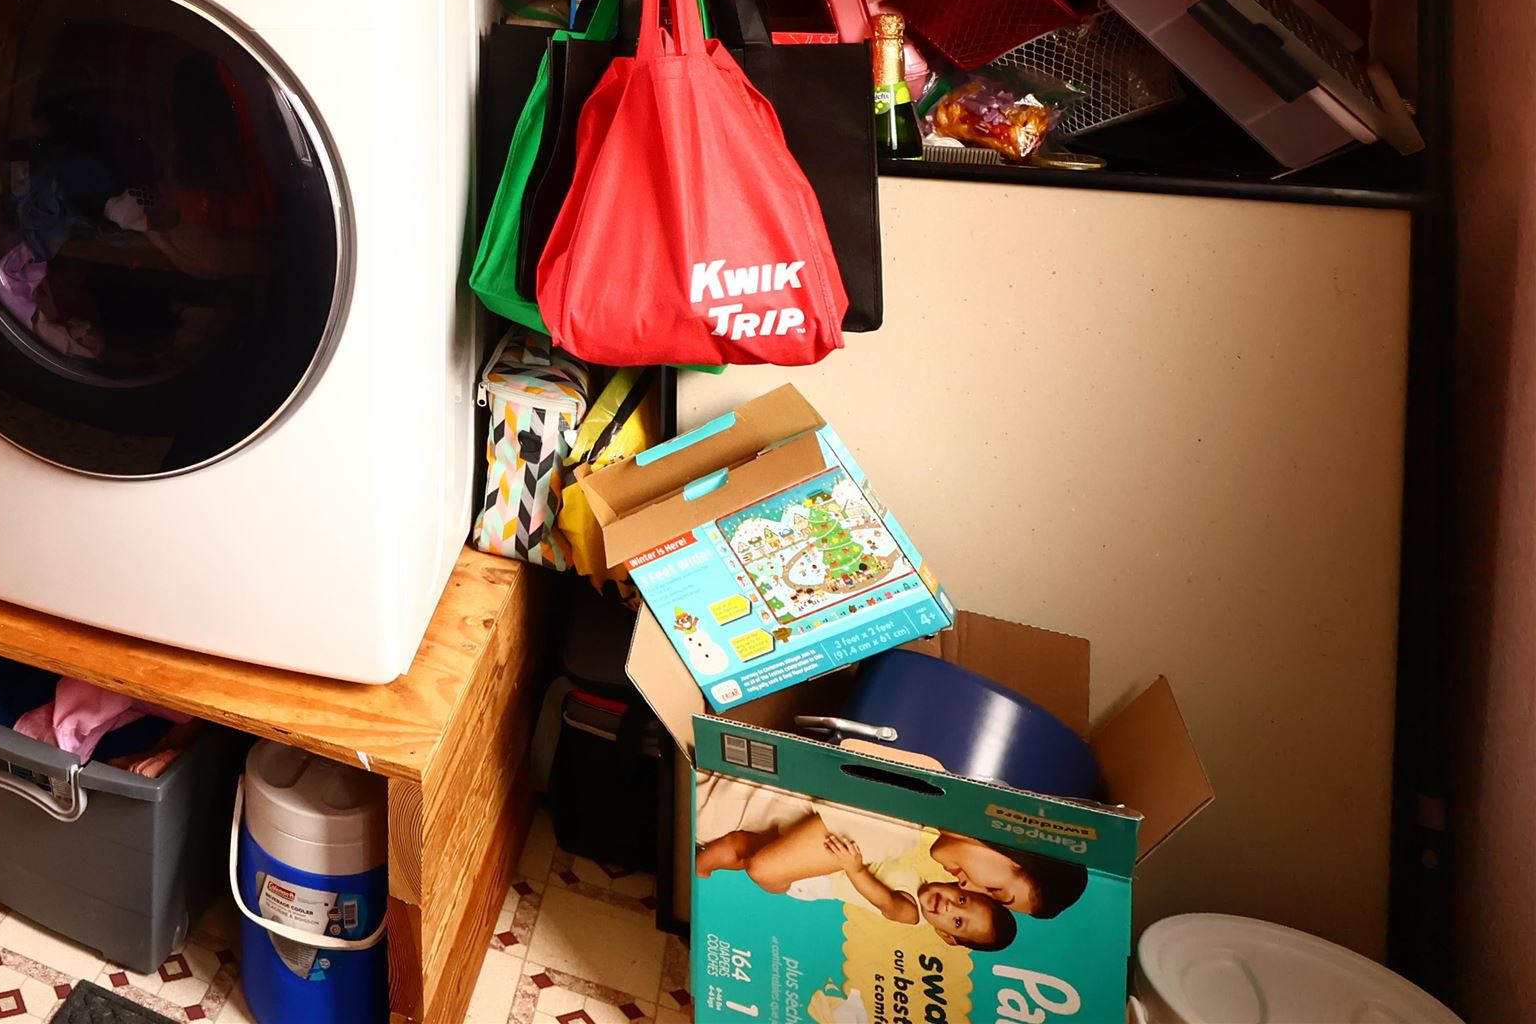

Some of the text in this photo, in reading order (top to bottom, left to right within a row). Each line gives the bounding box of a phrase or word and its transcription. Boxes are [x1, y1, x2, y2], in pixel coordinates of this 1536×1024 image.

[690, 259, 806, 303] KWIK
[708, 303, 805, 341] TRIP
[629, 537, 688, 568] Winter is Here!
[834, 640, 842, 649] 3
[841, 633, 860, 647] feet
[868, 626, 877, 636] 2
[876, 620, 896, 633] feet
[919, 612, 936, 625] 4+
[858, 641, 872, 652] cm
[879, 632, 892, 643] 61
[893, 625, 911, 638] cm)
[991, 820, 1089, 854] Pampers
[996, 809, 1089, 836] swaddlers
[265, 892, 314, 916] BEVERAGE COOLER
[707, 933, 719, 977] COUCHES
[718, 940, 730, 978] DIAPERS
[731, 948, 752, 983] 164
[782, 956, 804, 990] plus
[893, 949, 914, 1024] our best
[726, 1000, 759, 1017] 1
[874, 973, 888, 1024] & comf
[992, 964, 1081, 1024] Pa
